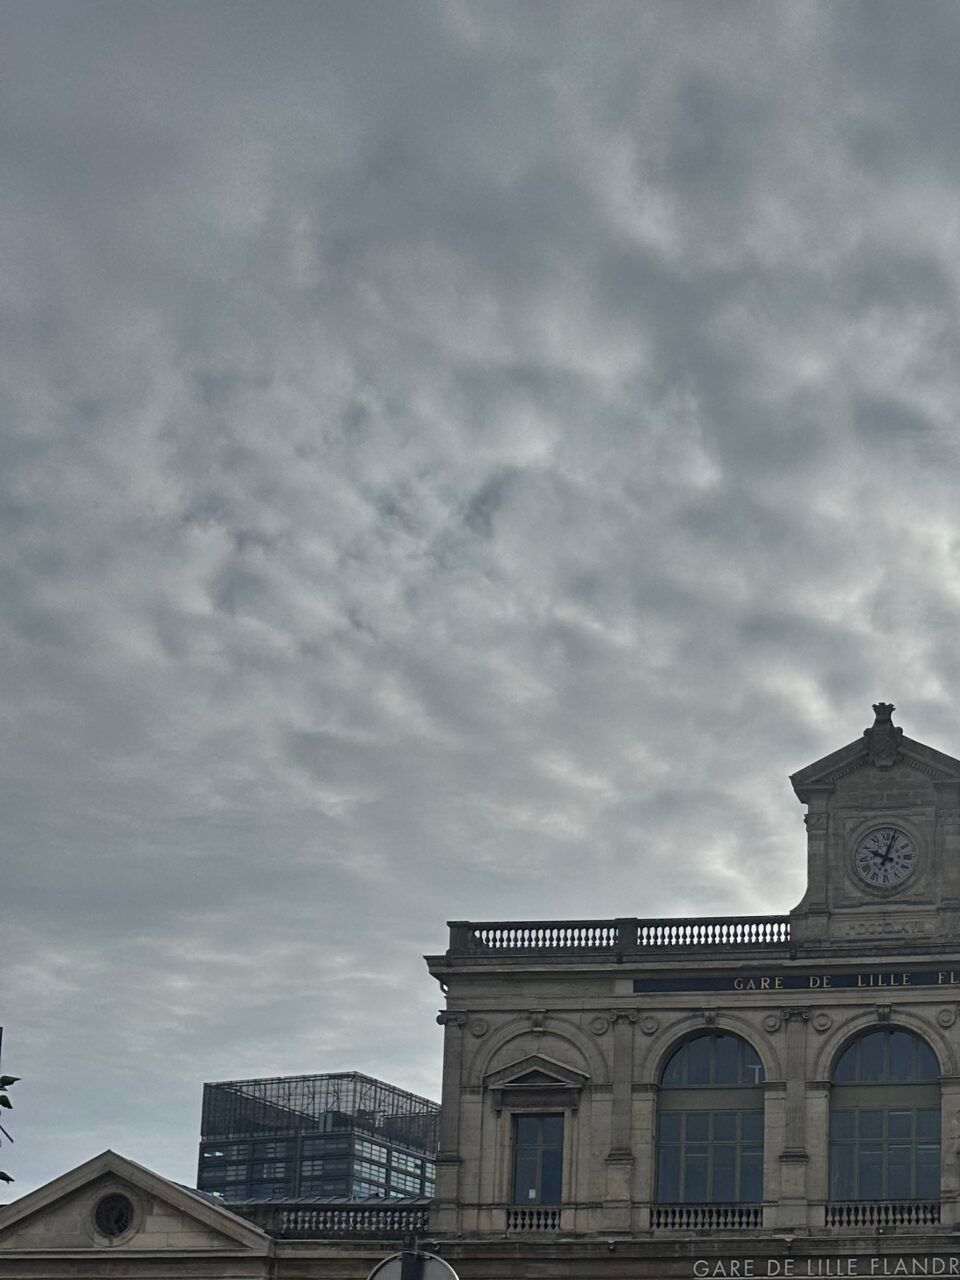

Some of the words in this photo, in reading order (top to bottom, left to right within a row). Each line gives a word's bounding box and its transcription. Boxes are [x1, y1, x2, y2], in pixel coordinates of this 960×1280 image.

[734, 976, 784, 990] GARE
[808, 975, 832, 989] DE
[857, 973, 912, 988] LILLE
[693, 1259, 755, 1277] GARE
[767, 1259, 794, 1277] DE
[807, 1258, 858, 1276] LILLE
